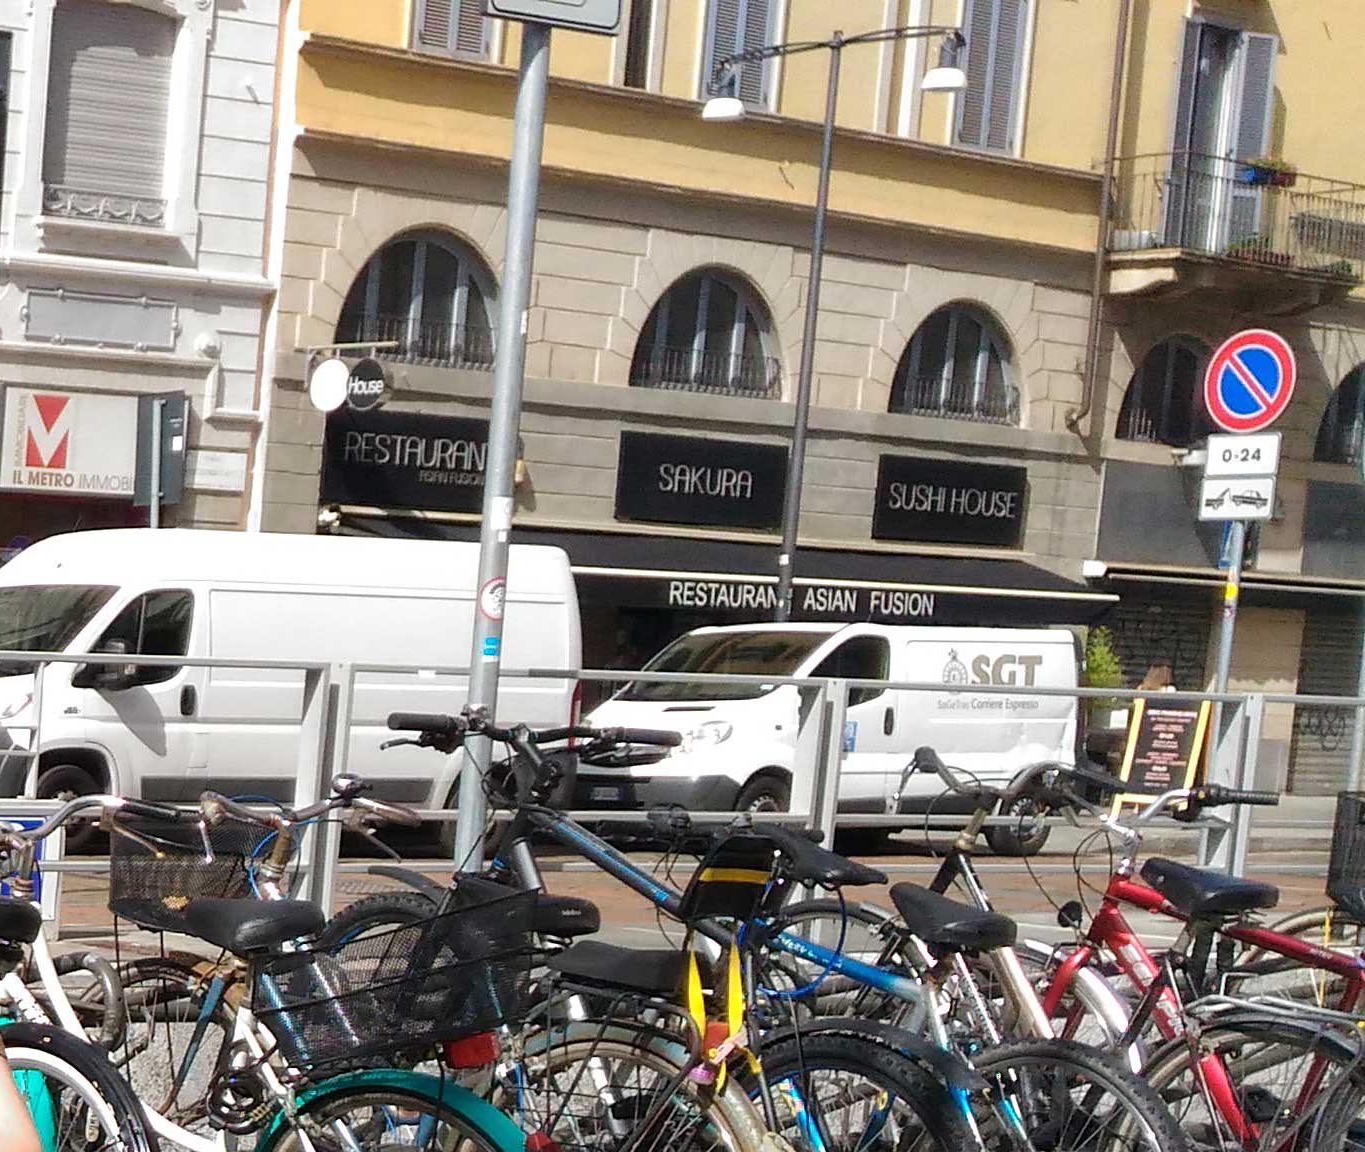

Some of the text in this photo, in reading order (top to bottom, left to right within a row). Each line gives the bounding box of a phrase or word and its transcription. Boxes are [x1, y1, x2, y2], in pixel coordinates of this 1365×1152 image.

[348, 376, 384, 395] House
[345, 431, 488, 471] RESTAURAN
[1222, 448, 1261, 463] 0-24
[12, 470, 23, 485] IL
[28, 471, 74, 488] METRO
[659, 463, 752, 498] SAKURA
[889, 482, 1018, 518] SUSHI HOUSE
[669, 581, 934, 616] RESTAURAN ASIAN FUSION
[971, 654, 1043, 687] SGT
